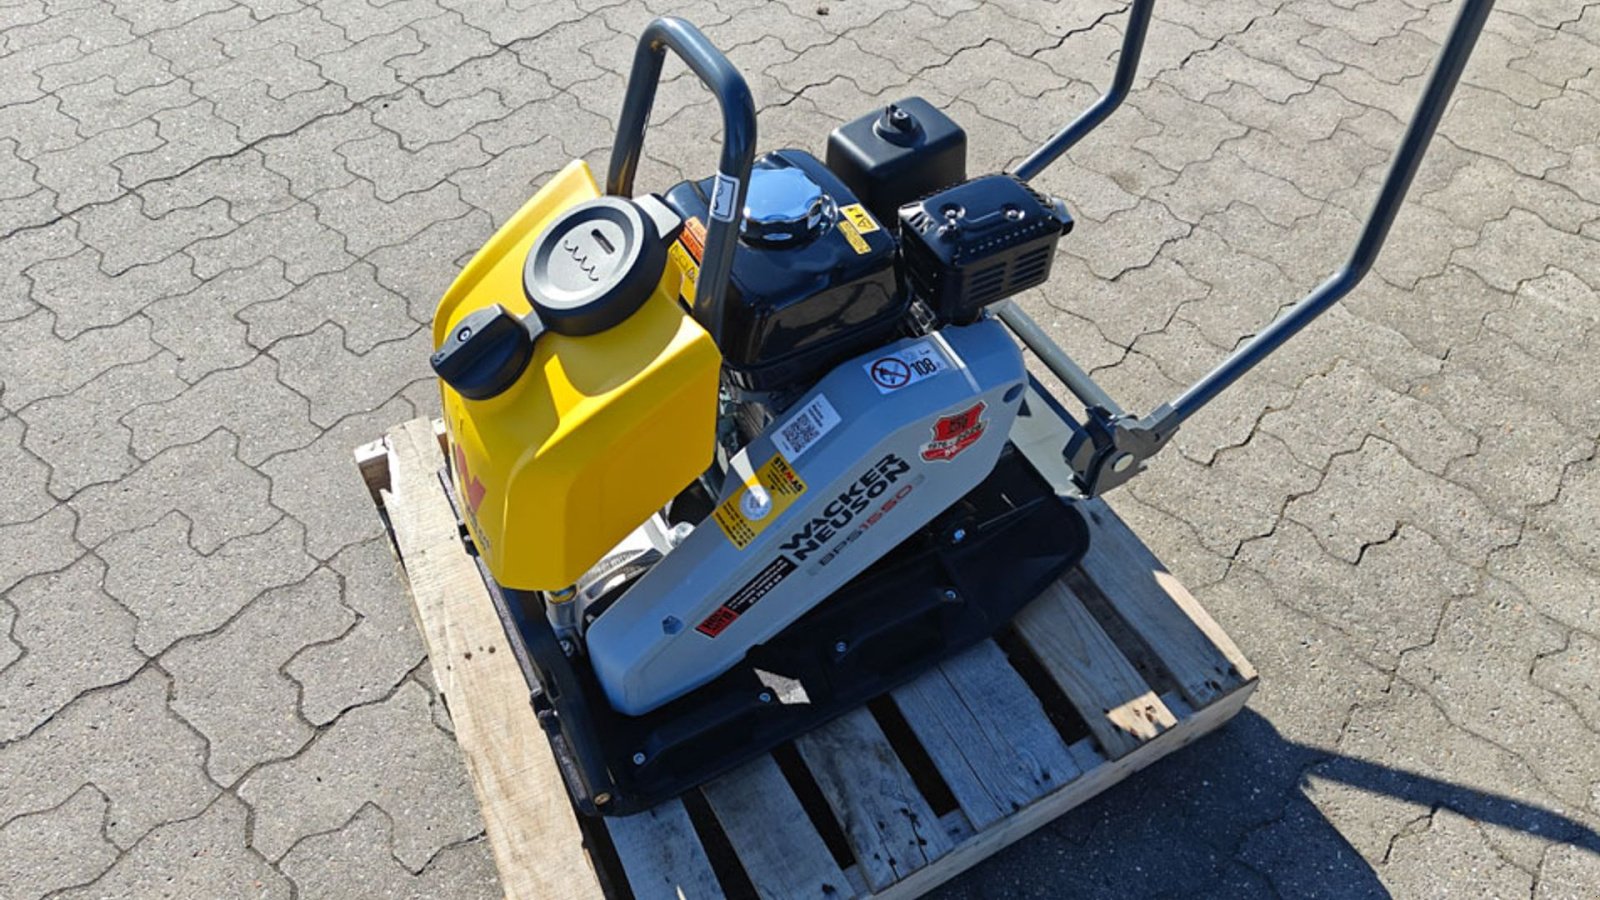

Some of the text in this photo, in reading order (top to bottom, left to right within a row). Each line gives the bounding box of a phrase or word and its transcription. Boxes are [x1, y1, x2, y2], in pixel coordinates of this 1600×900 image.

[910, 357, 937, 376] 108
[774, 457, 803, 492] STEMAS
[779, 453, 898, 550] WACKER
[793, 460, 910, 561] NEUSON
